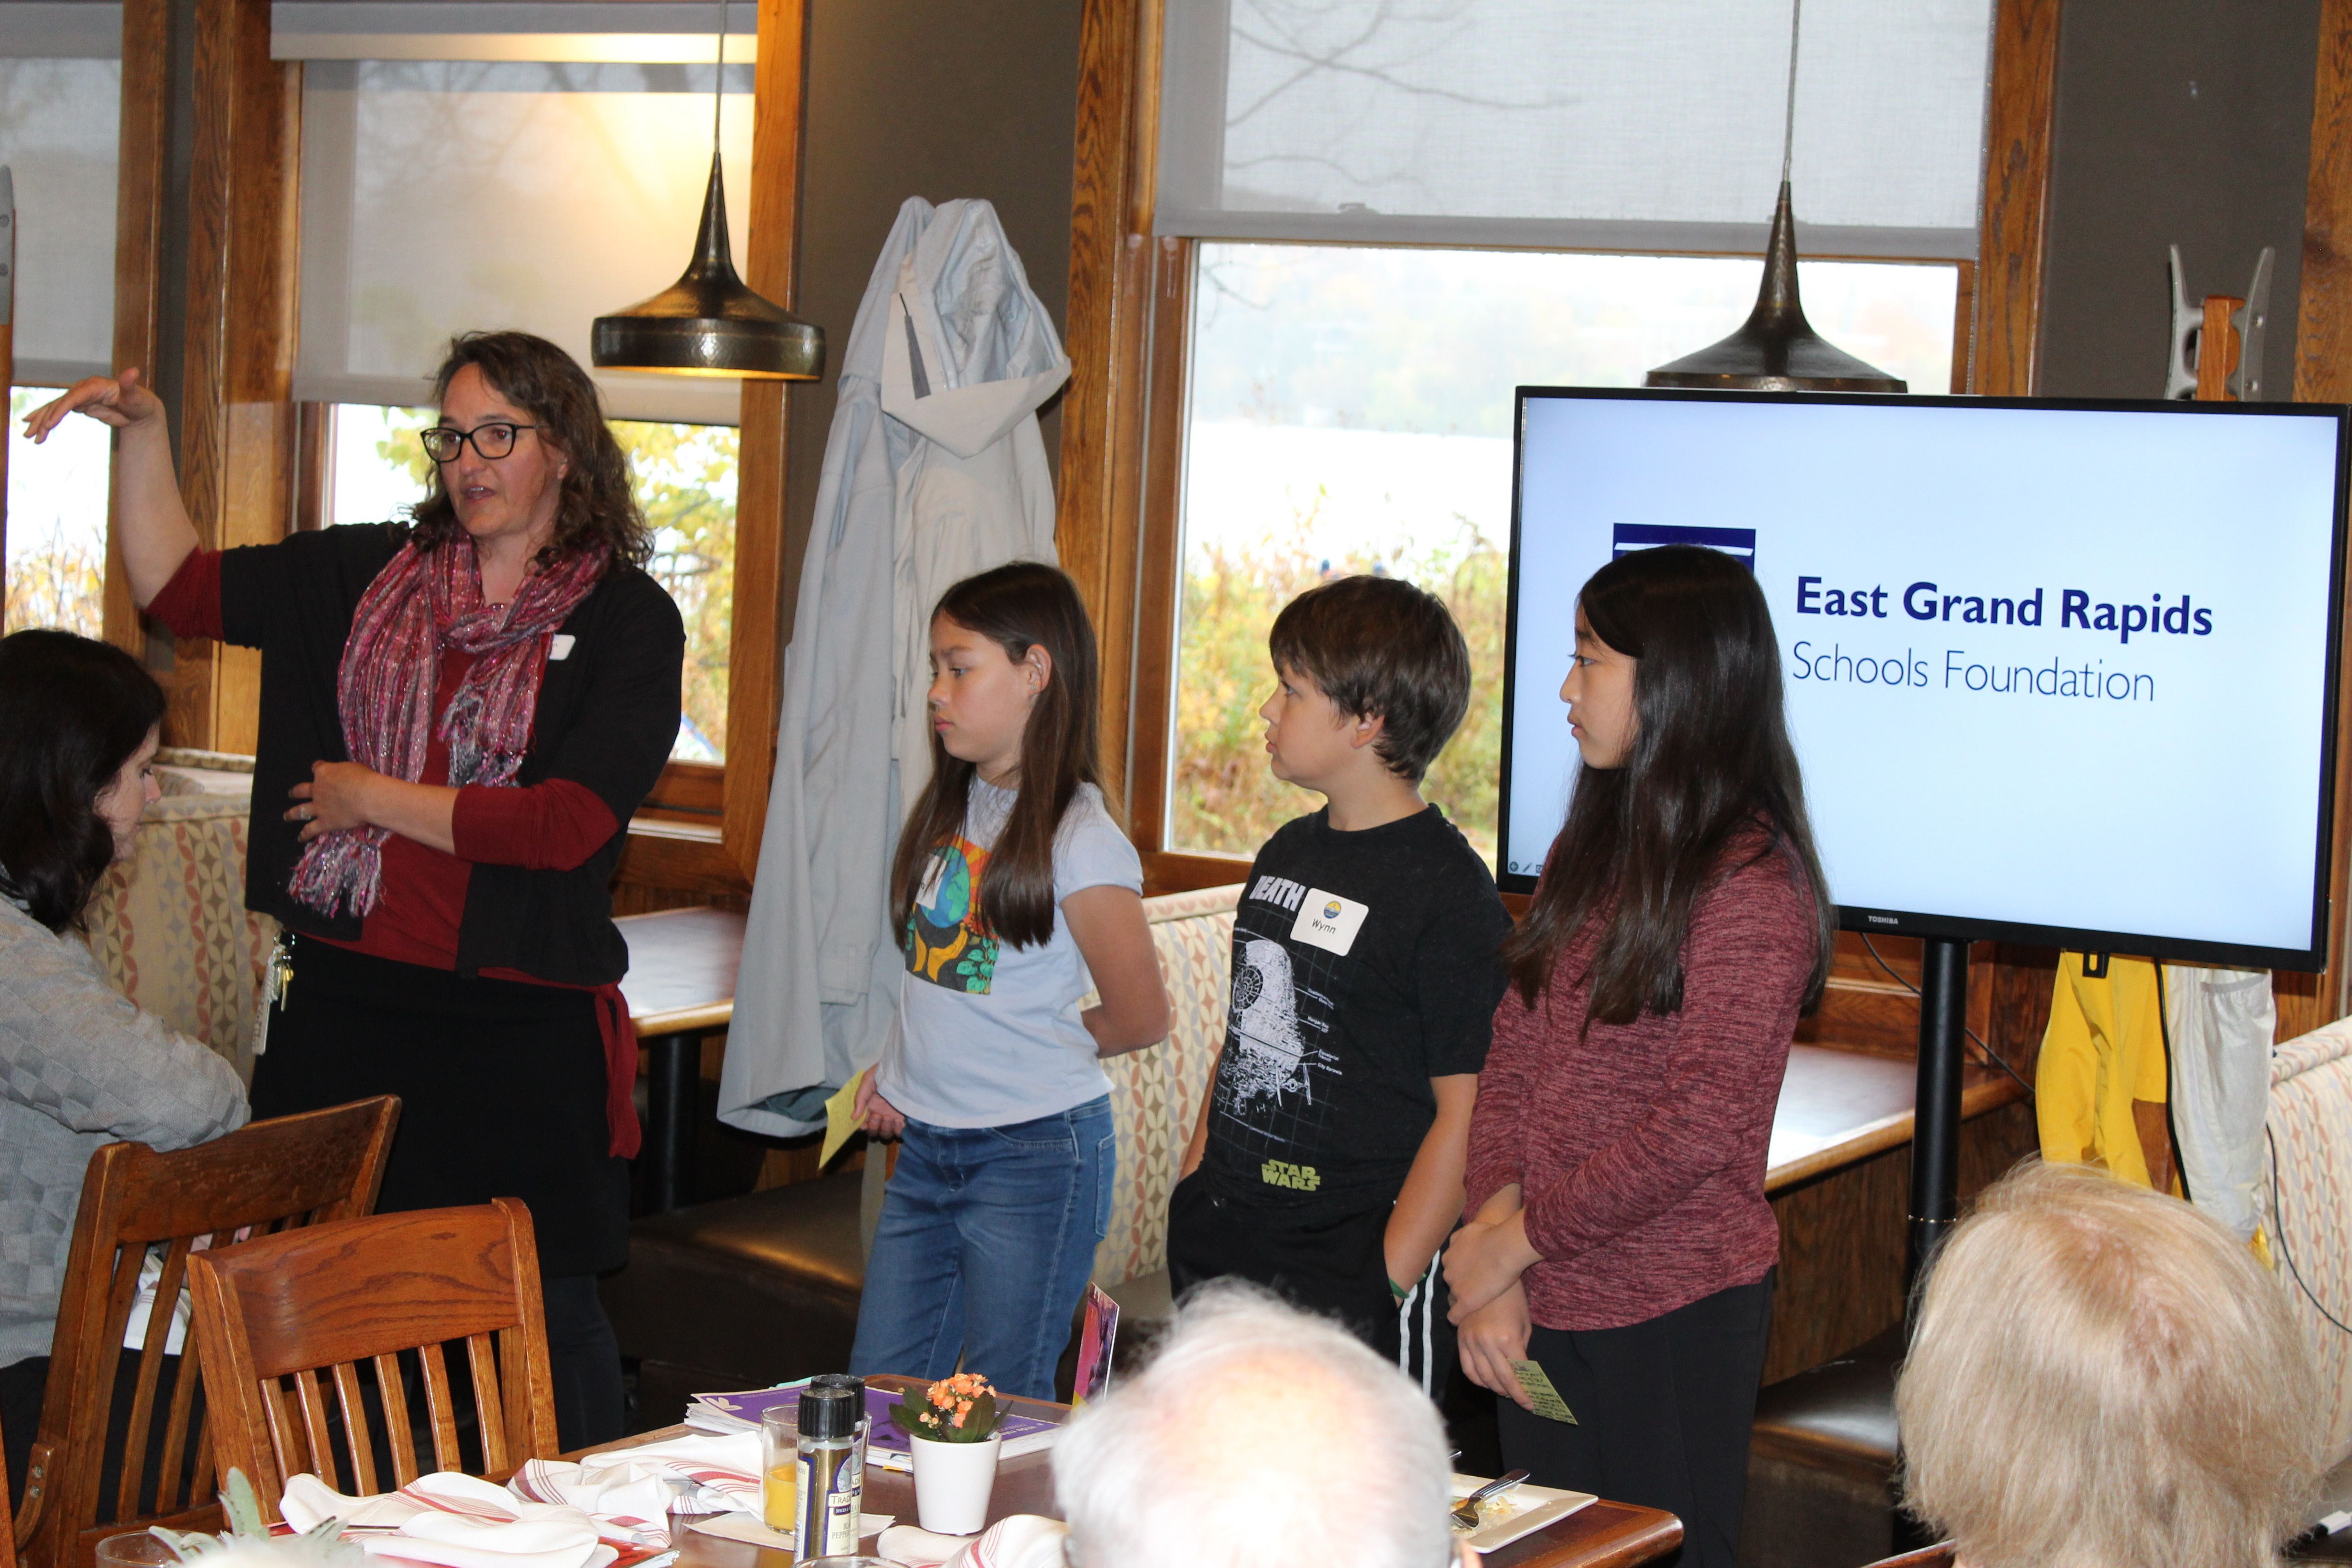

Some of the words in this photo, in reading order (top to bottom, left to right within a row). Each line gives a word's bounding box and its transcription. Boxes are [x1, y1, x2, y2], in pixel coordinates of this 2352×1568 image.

[1796, 575, 1888, 619] East
[1903, 581, 2043, 627] Grand
[2061, 588, 2213, 645] Rapids
[1793, 641, 1929, 689] Schools
[1945, 650, 2154, 702] Foundation
[1249, 875, 1306, 912] DEATH
[1312, 918, 1337, 935] Wynn
[1867, 915, 1899, 925] TOSHIBA
[1261, 1159, 1321, 1181] STAR
[1261, 1168, 1321, 1191] WARS
